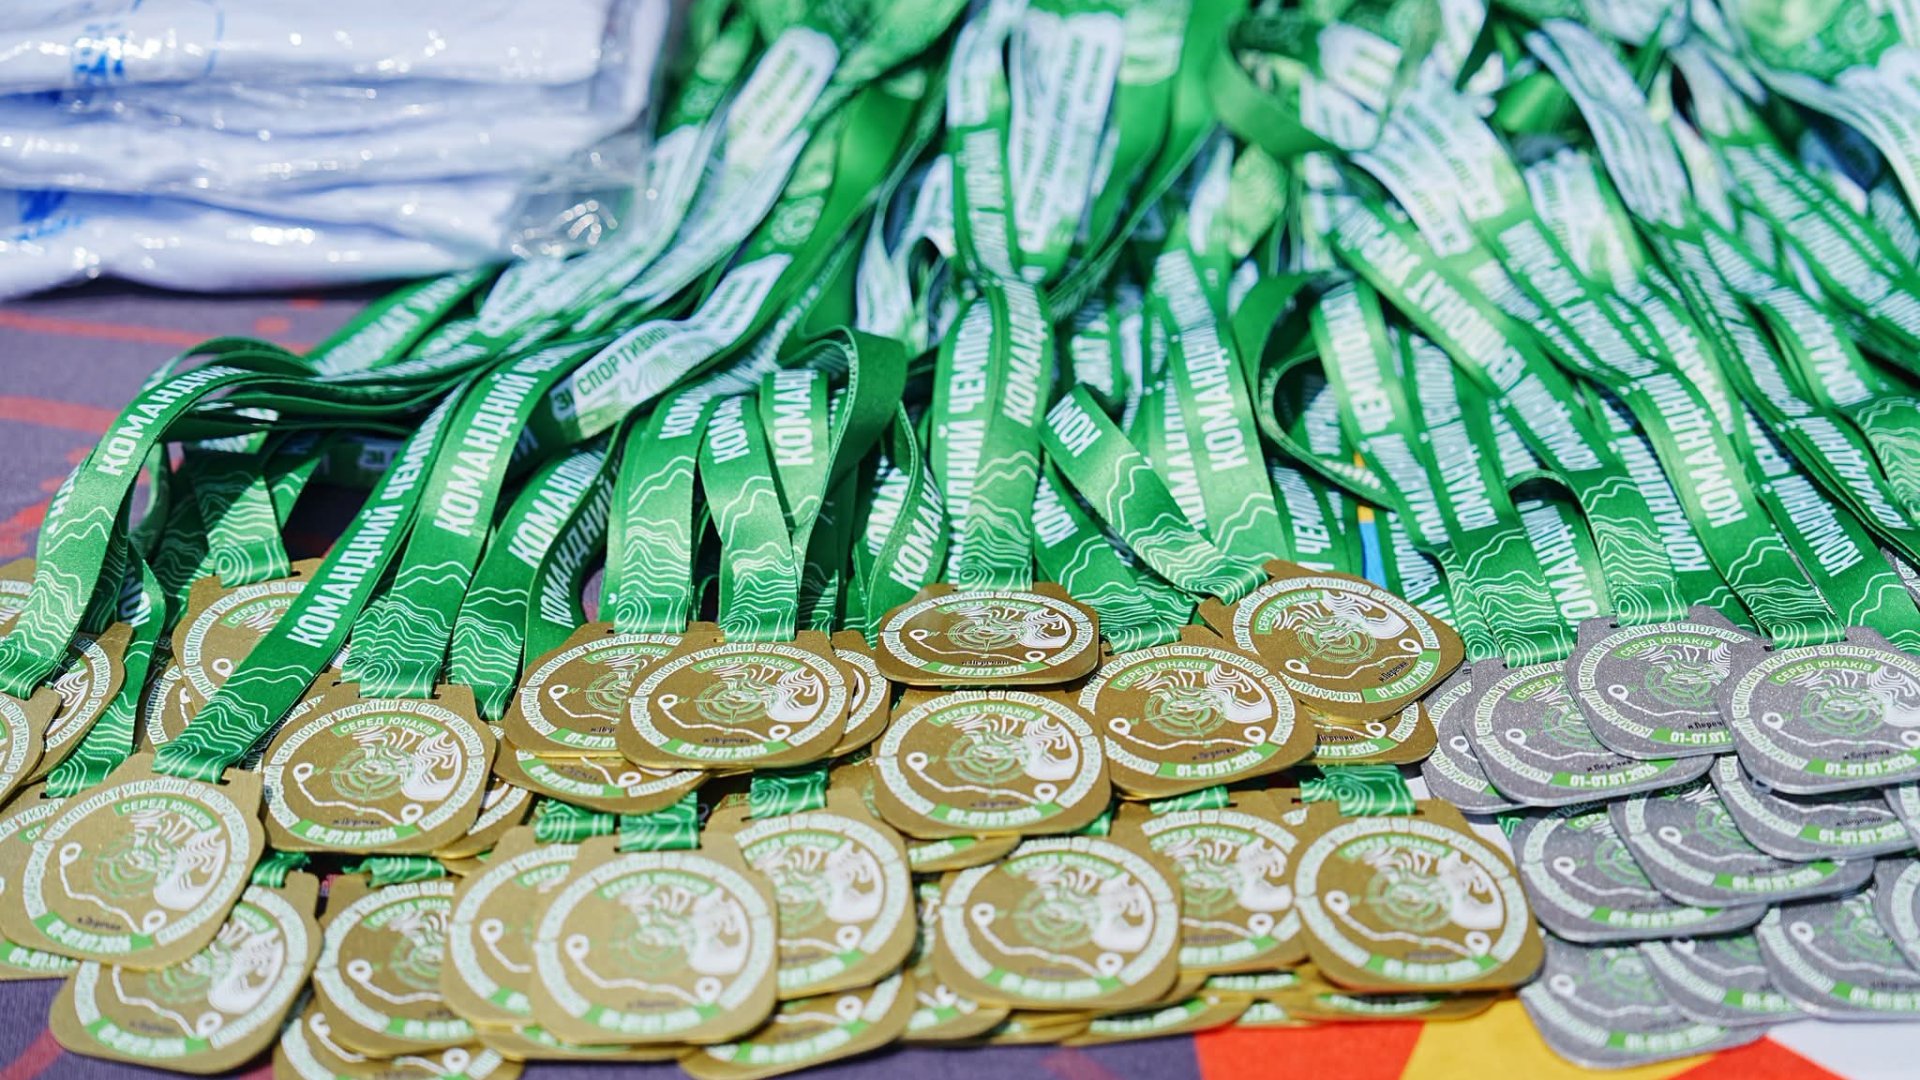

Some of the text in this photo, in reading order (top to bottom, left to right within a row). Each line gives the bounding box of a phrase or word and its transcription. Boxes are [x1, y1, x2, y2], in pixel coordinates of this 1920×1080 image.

[434, 373, 538, 537] КОМАНДНИЙ
[1619, 372, 1748, 528] КОМАНДНИЙ
[286, 505, 404, 648] КОМАНДНИЙ
[228, 602, 266, 624] СЕРЕД
[943, 600, 1037, 612] СЕРЕД ЮНАКІВ
[1677, 623, 1751, 643] СПОРТИВ
[592, 646, 668, 661] СЕРЕД ЮНА
[1620, 636, 1714, 656] СЕРЕД ЮНАКІВ
[700, 657, 794, 671] СЕРЕД ЮНАКІВ
[1170, 646, 1269, 677] СПОРТИВНОГО
[1775, 660, 1873, 682] СЕРЕД ЮНАКІВ
[1836, 645, 1920, 679] СПОРТИВНО
[1117, 660, 1208, 686] СЕРЕД ЮНАКІВ
[1516, 677, 1553, 698] СЕРЕД
[937, 704, 1036, 724] СЕРЕД ЮНАКІВ
[340, 717, 437, 735] СЕРЕД ЮНАКІВ
[122, 799, 166, 812] СЕРЕД
